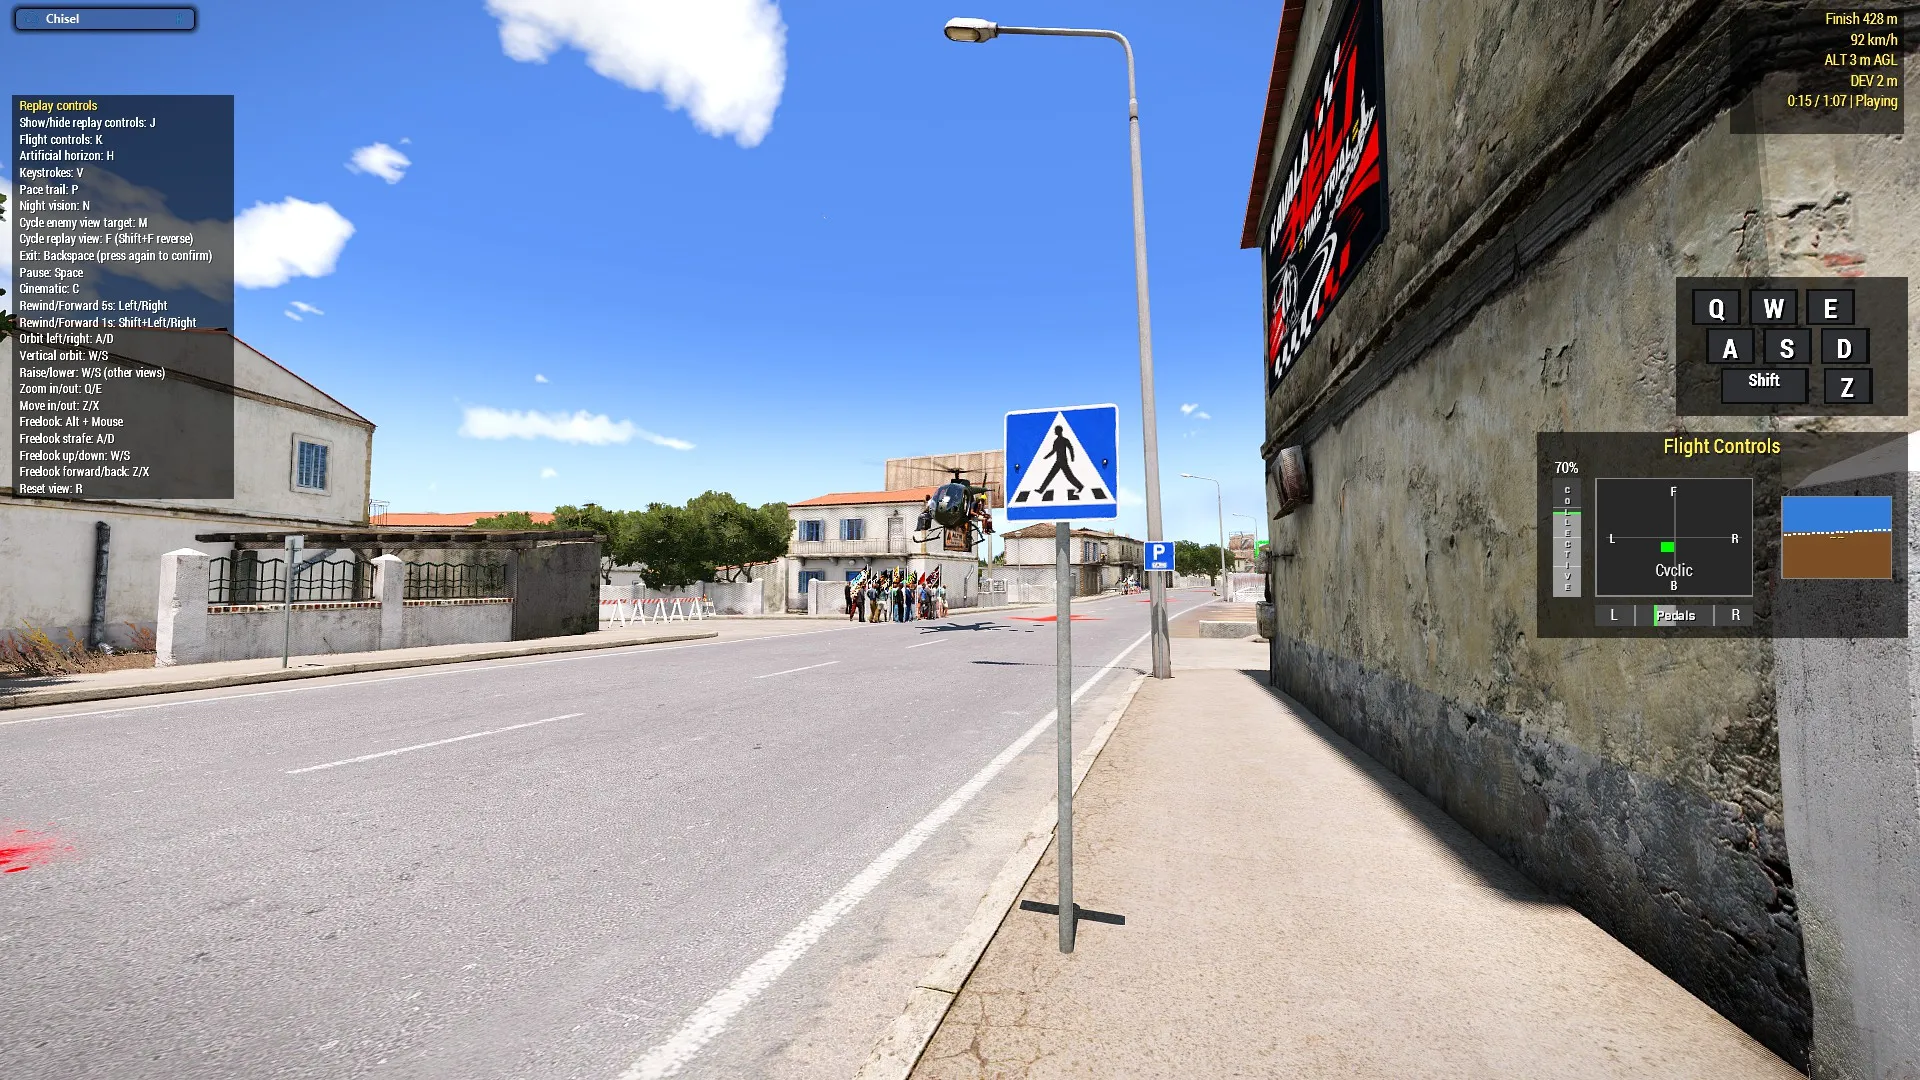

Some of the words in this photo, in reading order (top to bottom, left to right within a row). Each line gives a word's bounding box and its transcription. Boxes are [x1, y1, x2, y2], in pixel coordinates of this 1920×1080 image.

[1270, 129, 1310, 255] KAVALA
[1282, 45, 1358, 257] HELI
[1303, 194, 1323, 250] TIME
[1324, 135, 1352, 208] TRIAL
[1153, 543, 1166, 561] P
